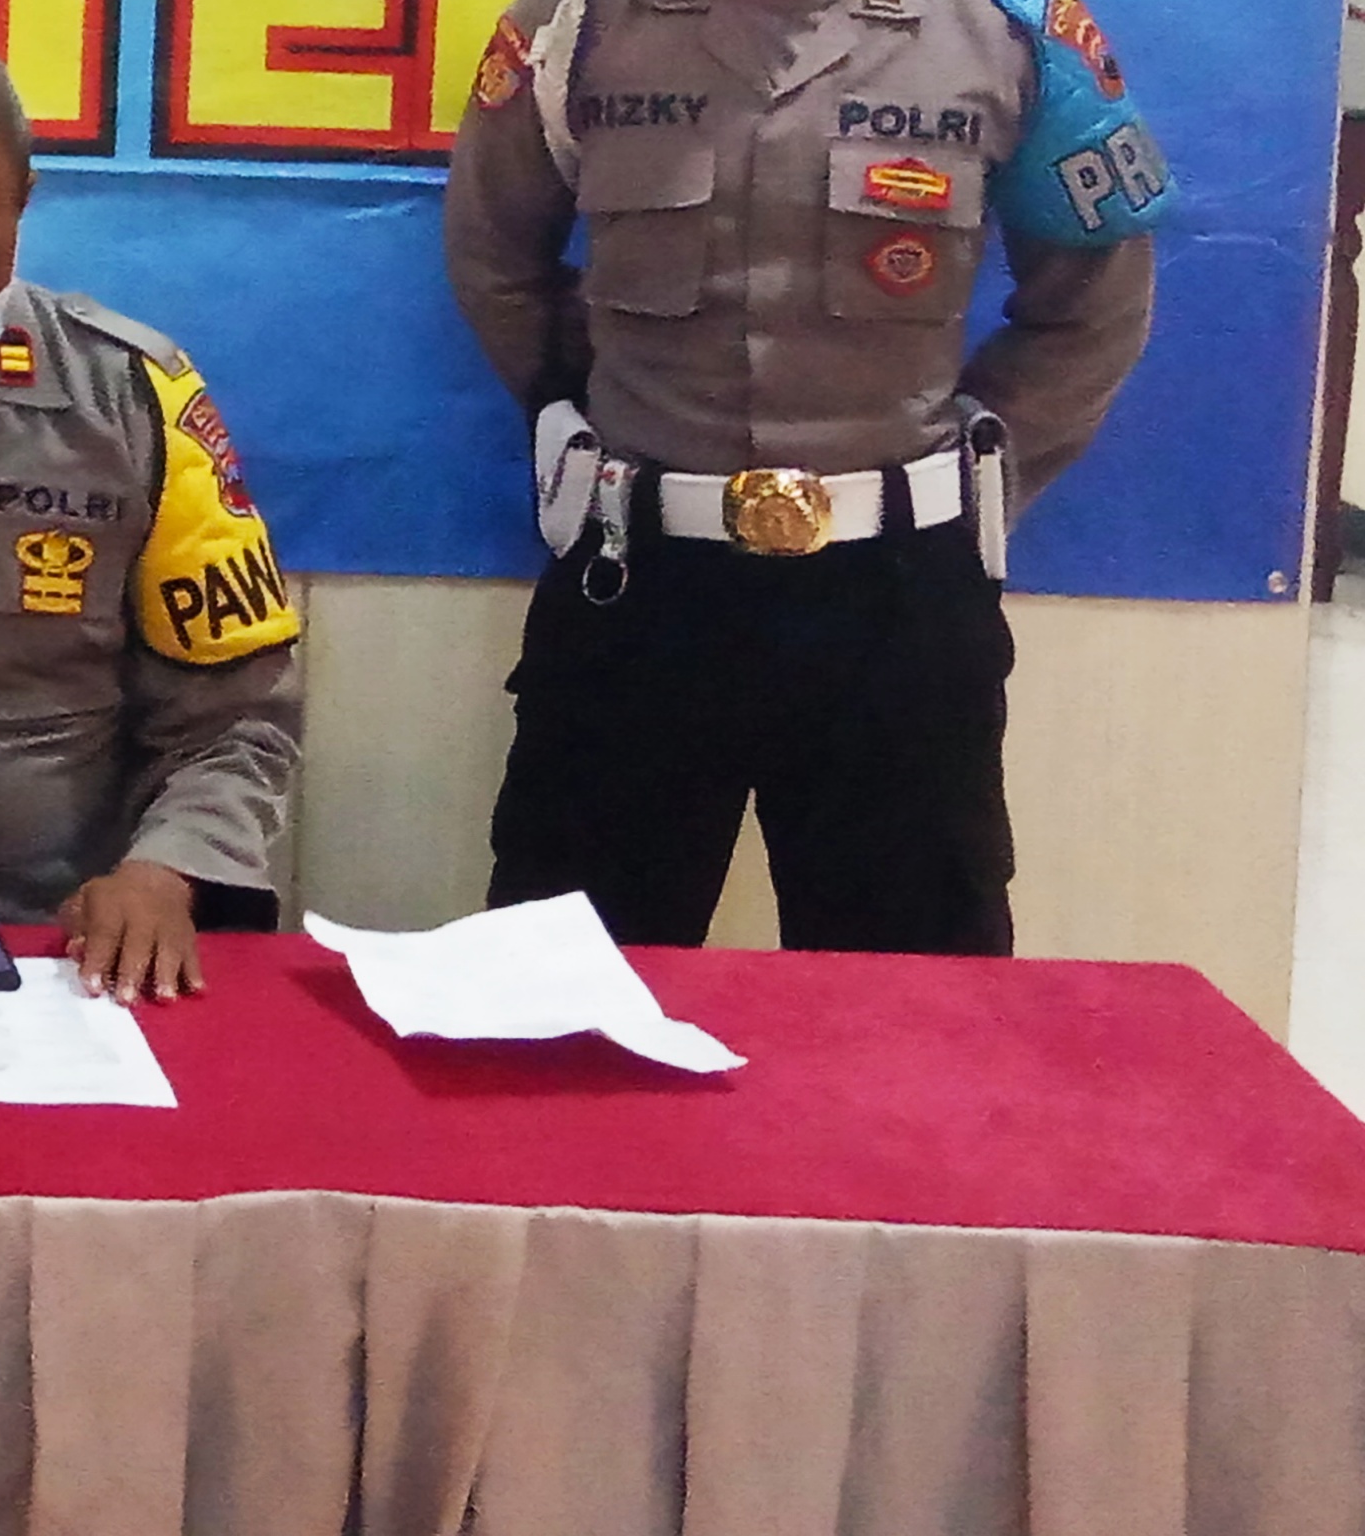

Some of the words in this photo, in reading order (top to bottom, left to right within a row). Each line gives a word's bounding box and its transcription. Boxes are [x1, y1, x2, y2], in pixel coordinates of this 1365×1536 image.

[569, 91, 708, 130] RIZKY
[838, 101, 982, 145] POLRI
[1049, 122, 1166, 232] PR
